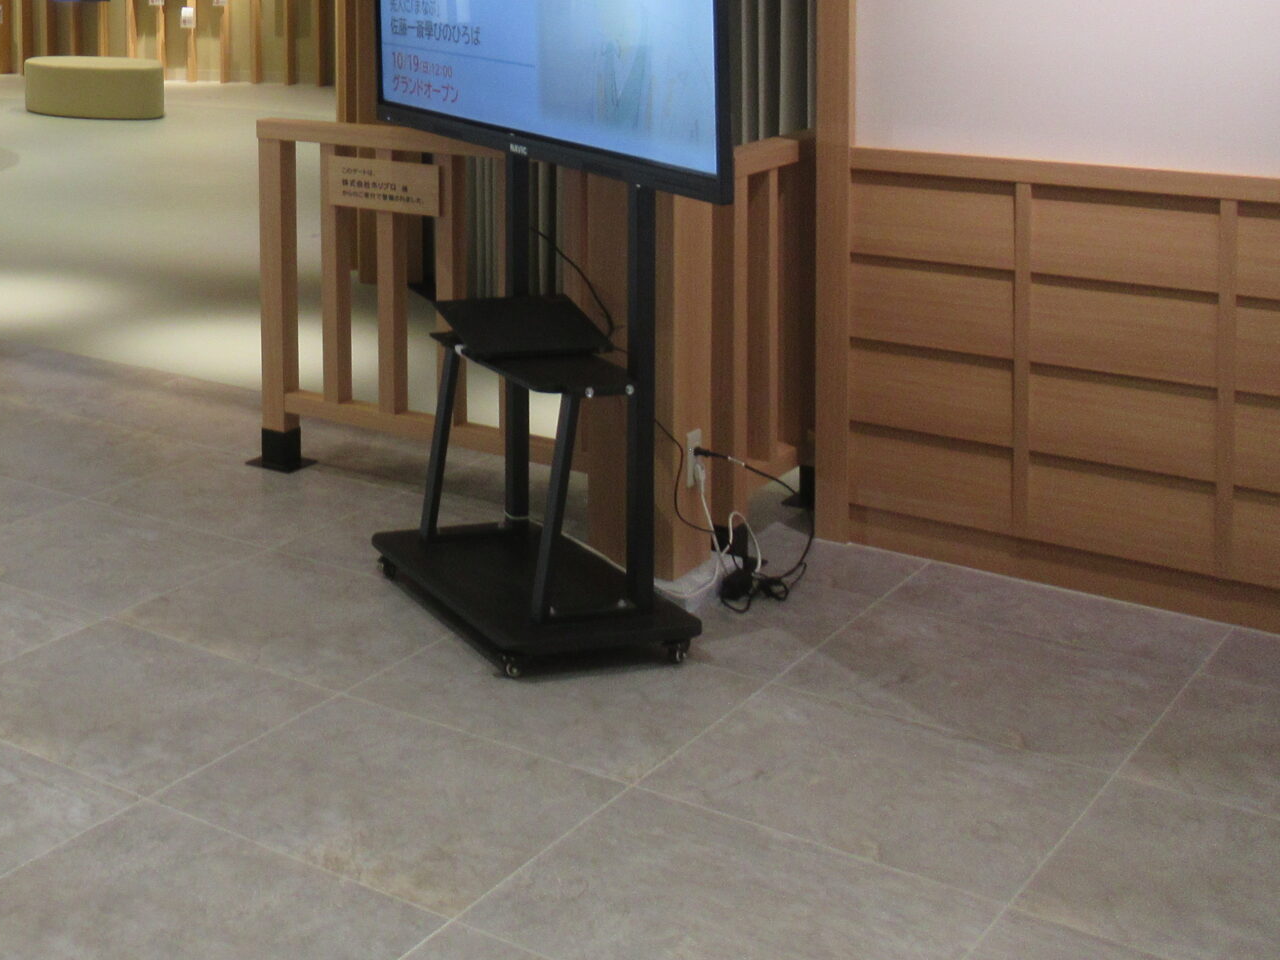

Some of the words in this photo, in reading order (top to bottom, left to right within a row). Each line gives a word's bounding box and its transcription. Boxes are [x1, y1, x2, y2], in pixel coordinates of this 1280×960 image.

[392, 73, 460, 104] グランドオープン
